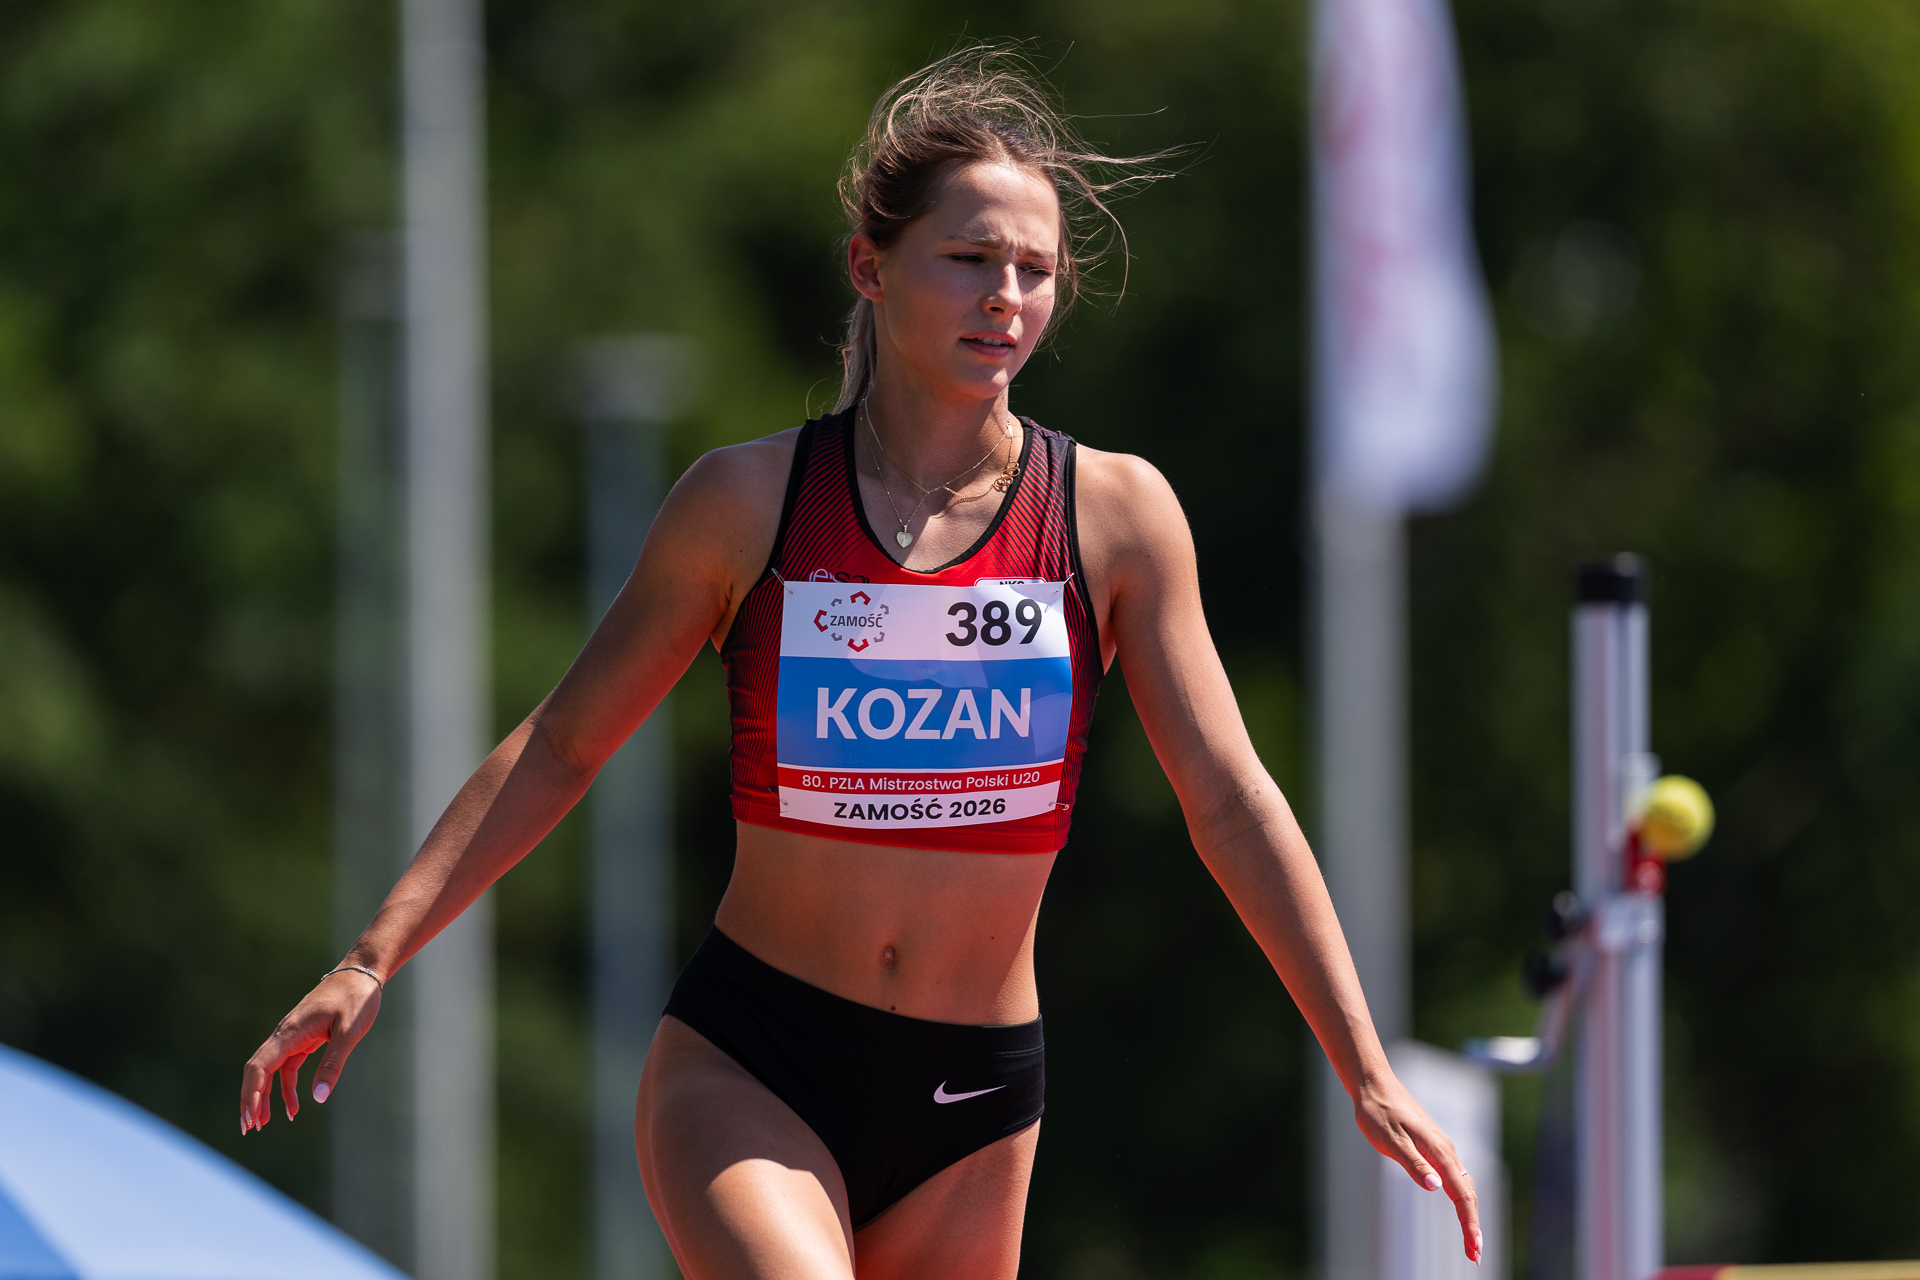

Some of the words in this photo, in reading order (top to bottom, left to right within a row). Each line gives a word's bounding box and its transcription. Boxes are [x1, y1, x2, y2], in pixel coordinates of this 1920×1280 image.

[829, 613, 884, 629] ZAMOŚĆ
[945, 598, 1042, 647] 389
[816, 687, 1032, 741] KOZAN
[802, 774, 825, 789] 80.
[829, 777, 865, 790] PZLA
[869, 777, 962, 791] Mistrzostwa
[966, 773, 1009, 789] Polski
[1013, 771, 1040, 785] U20
[834, 797, 943, 821] ZAMOŚĆ
[949, 798, 1006, 819] 2026
